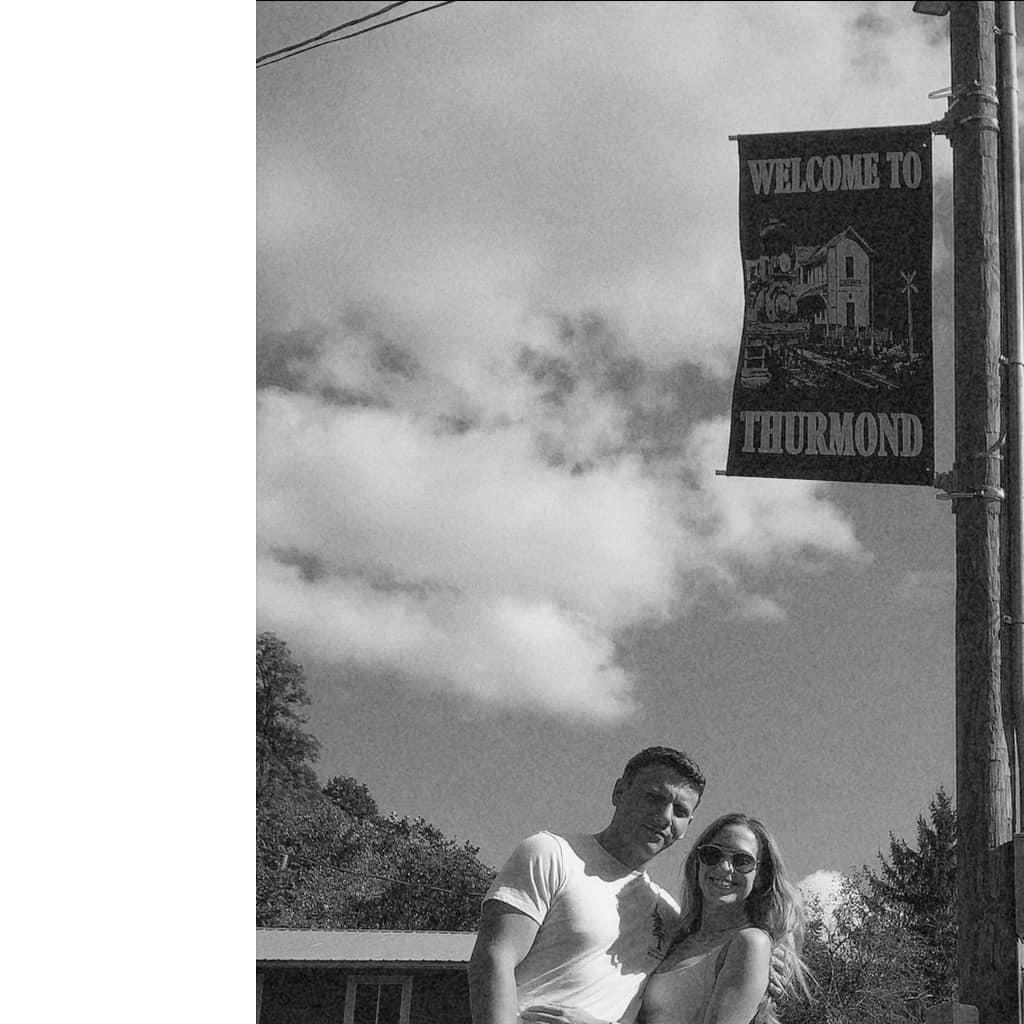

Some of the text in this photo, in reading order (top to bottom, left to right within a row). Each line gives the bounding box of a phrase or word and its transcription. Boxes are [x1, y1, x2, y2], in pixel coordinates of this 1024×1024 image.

[748, 151, 922, 195] WELCOME TO
[740, 411, 923, 457] THURMOND
